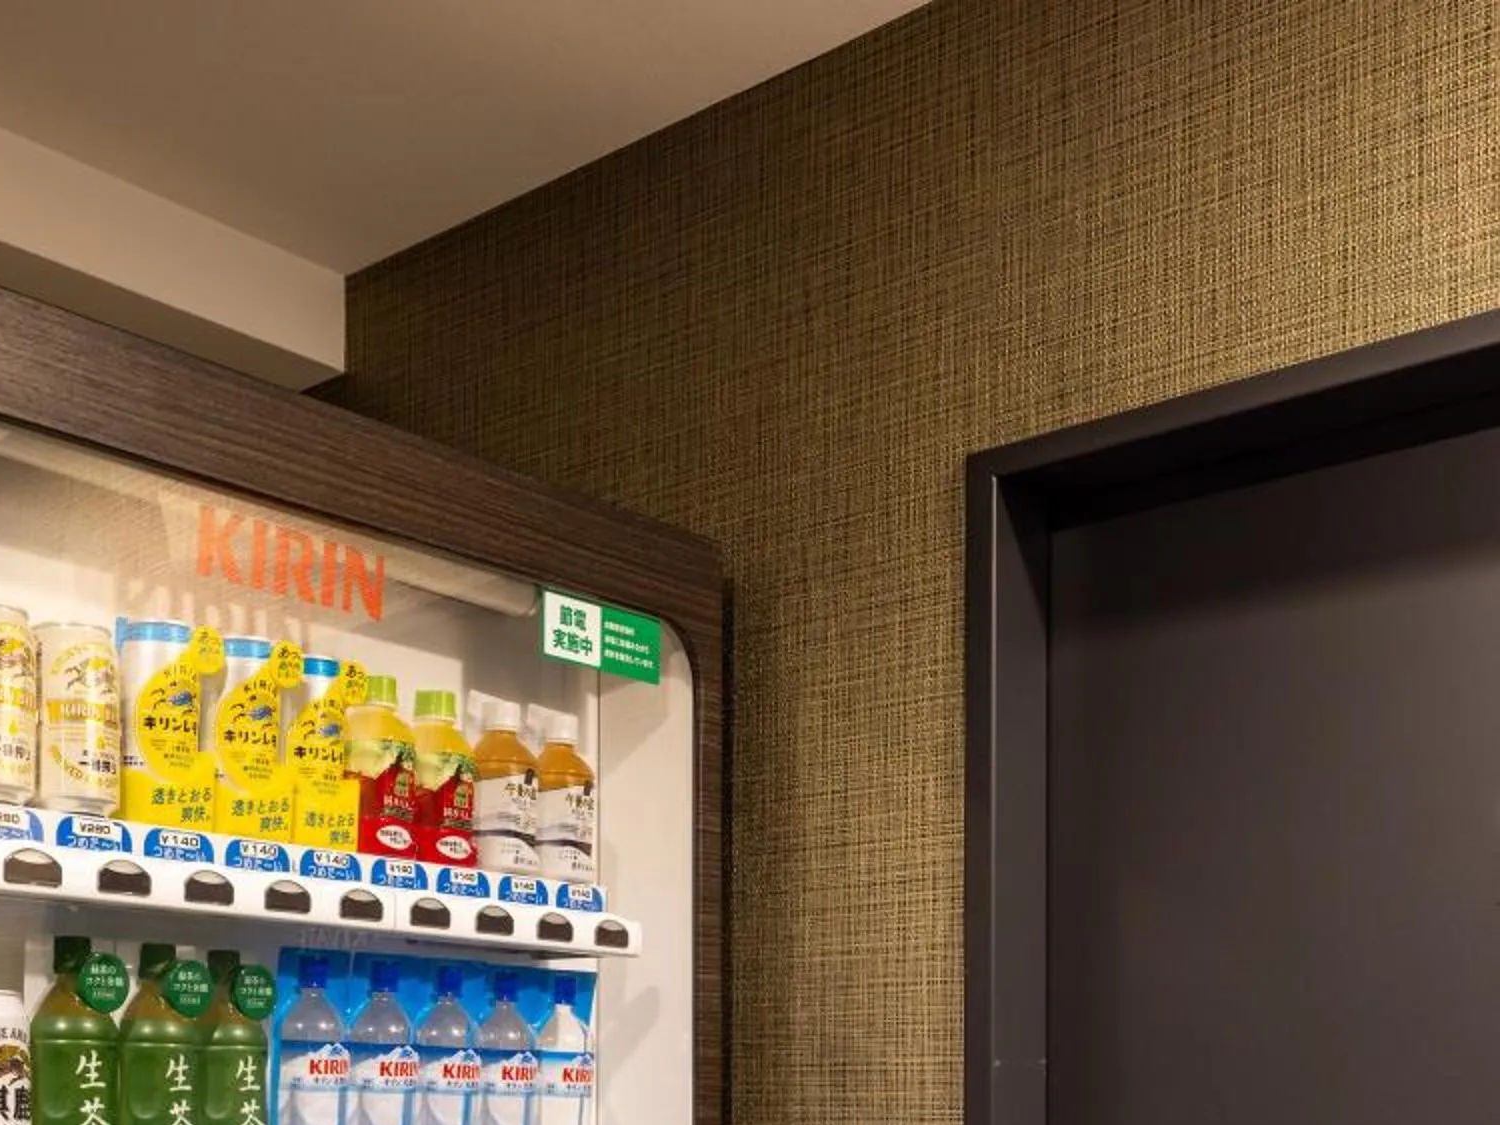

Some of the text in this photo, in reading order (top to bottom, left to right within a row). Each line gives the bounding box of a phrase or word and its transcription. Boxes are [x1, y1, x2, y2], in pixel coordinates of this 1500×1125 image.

[198, 504, 385, 622] KIRIN
[294, 746, 344, 763] キリンレ
[161, 834, 199, 848] ¥140
[242, 844, 276, 856] ¥140
